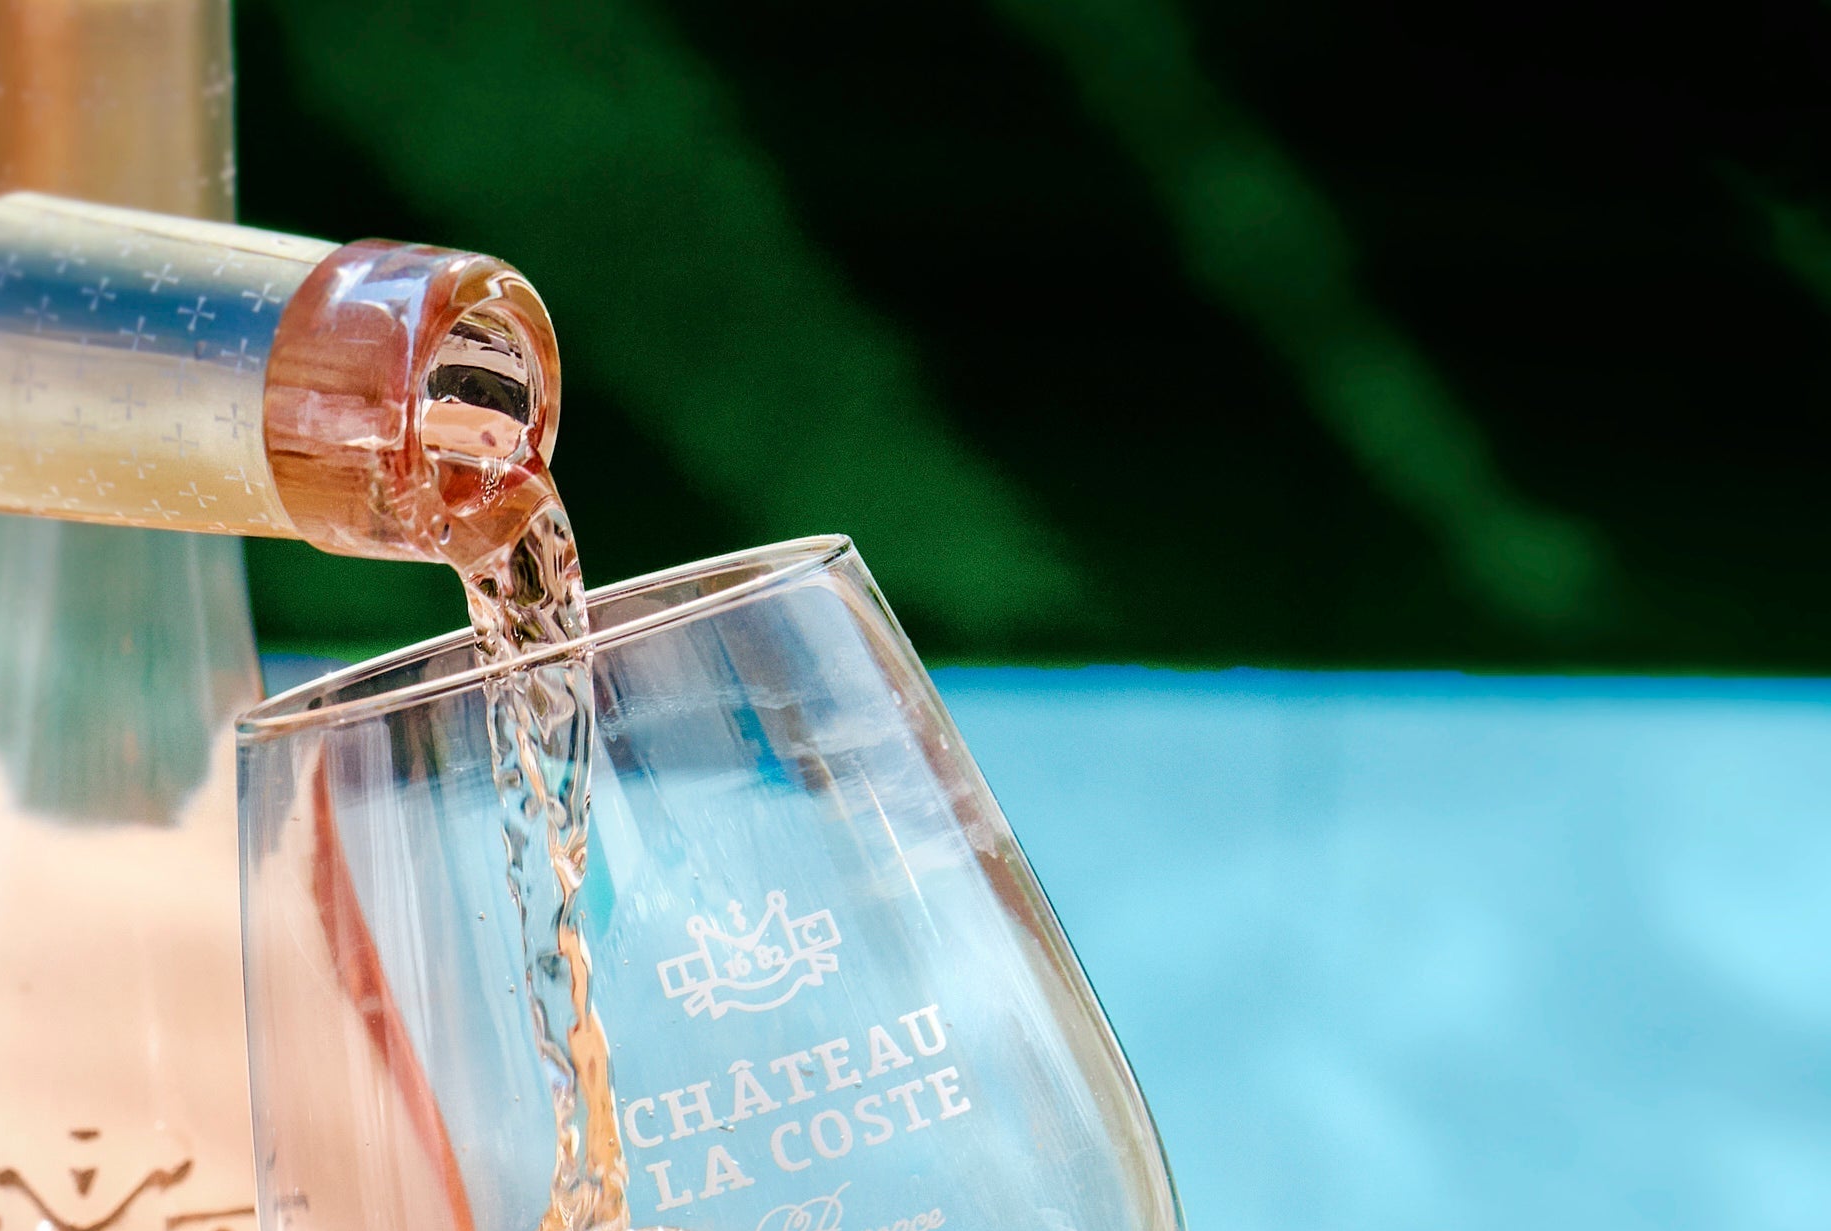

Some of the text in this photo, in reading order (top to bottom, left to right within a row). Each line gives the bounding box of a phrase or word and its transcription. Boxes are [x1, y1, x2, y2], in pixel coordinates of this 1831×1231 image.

[623, 1003, 949, 1149] CHÂTEAU
[645, 1065, 972, 1212] LA COSTE
